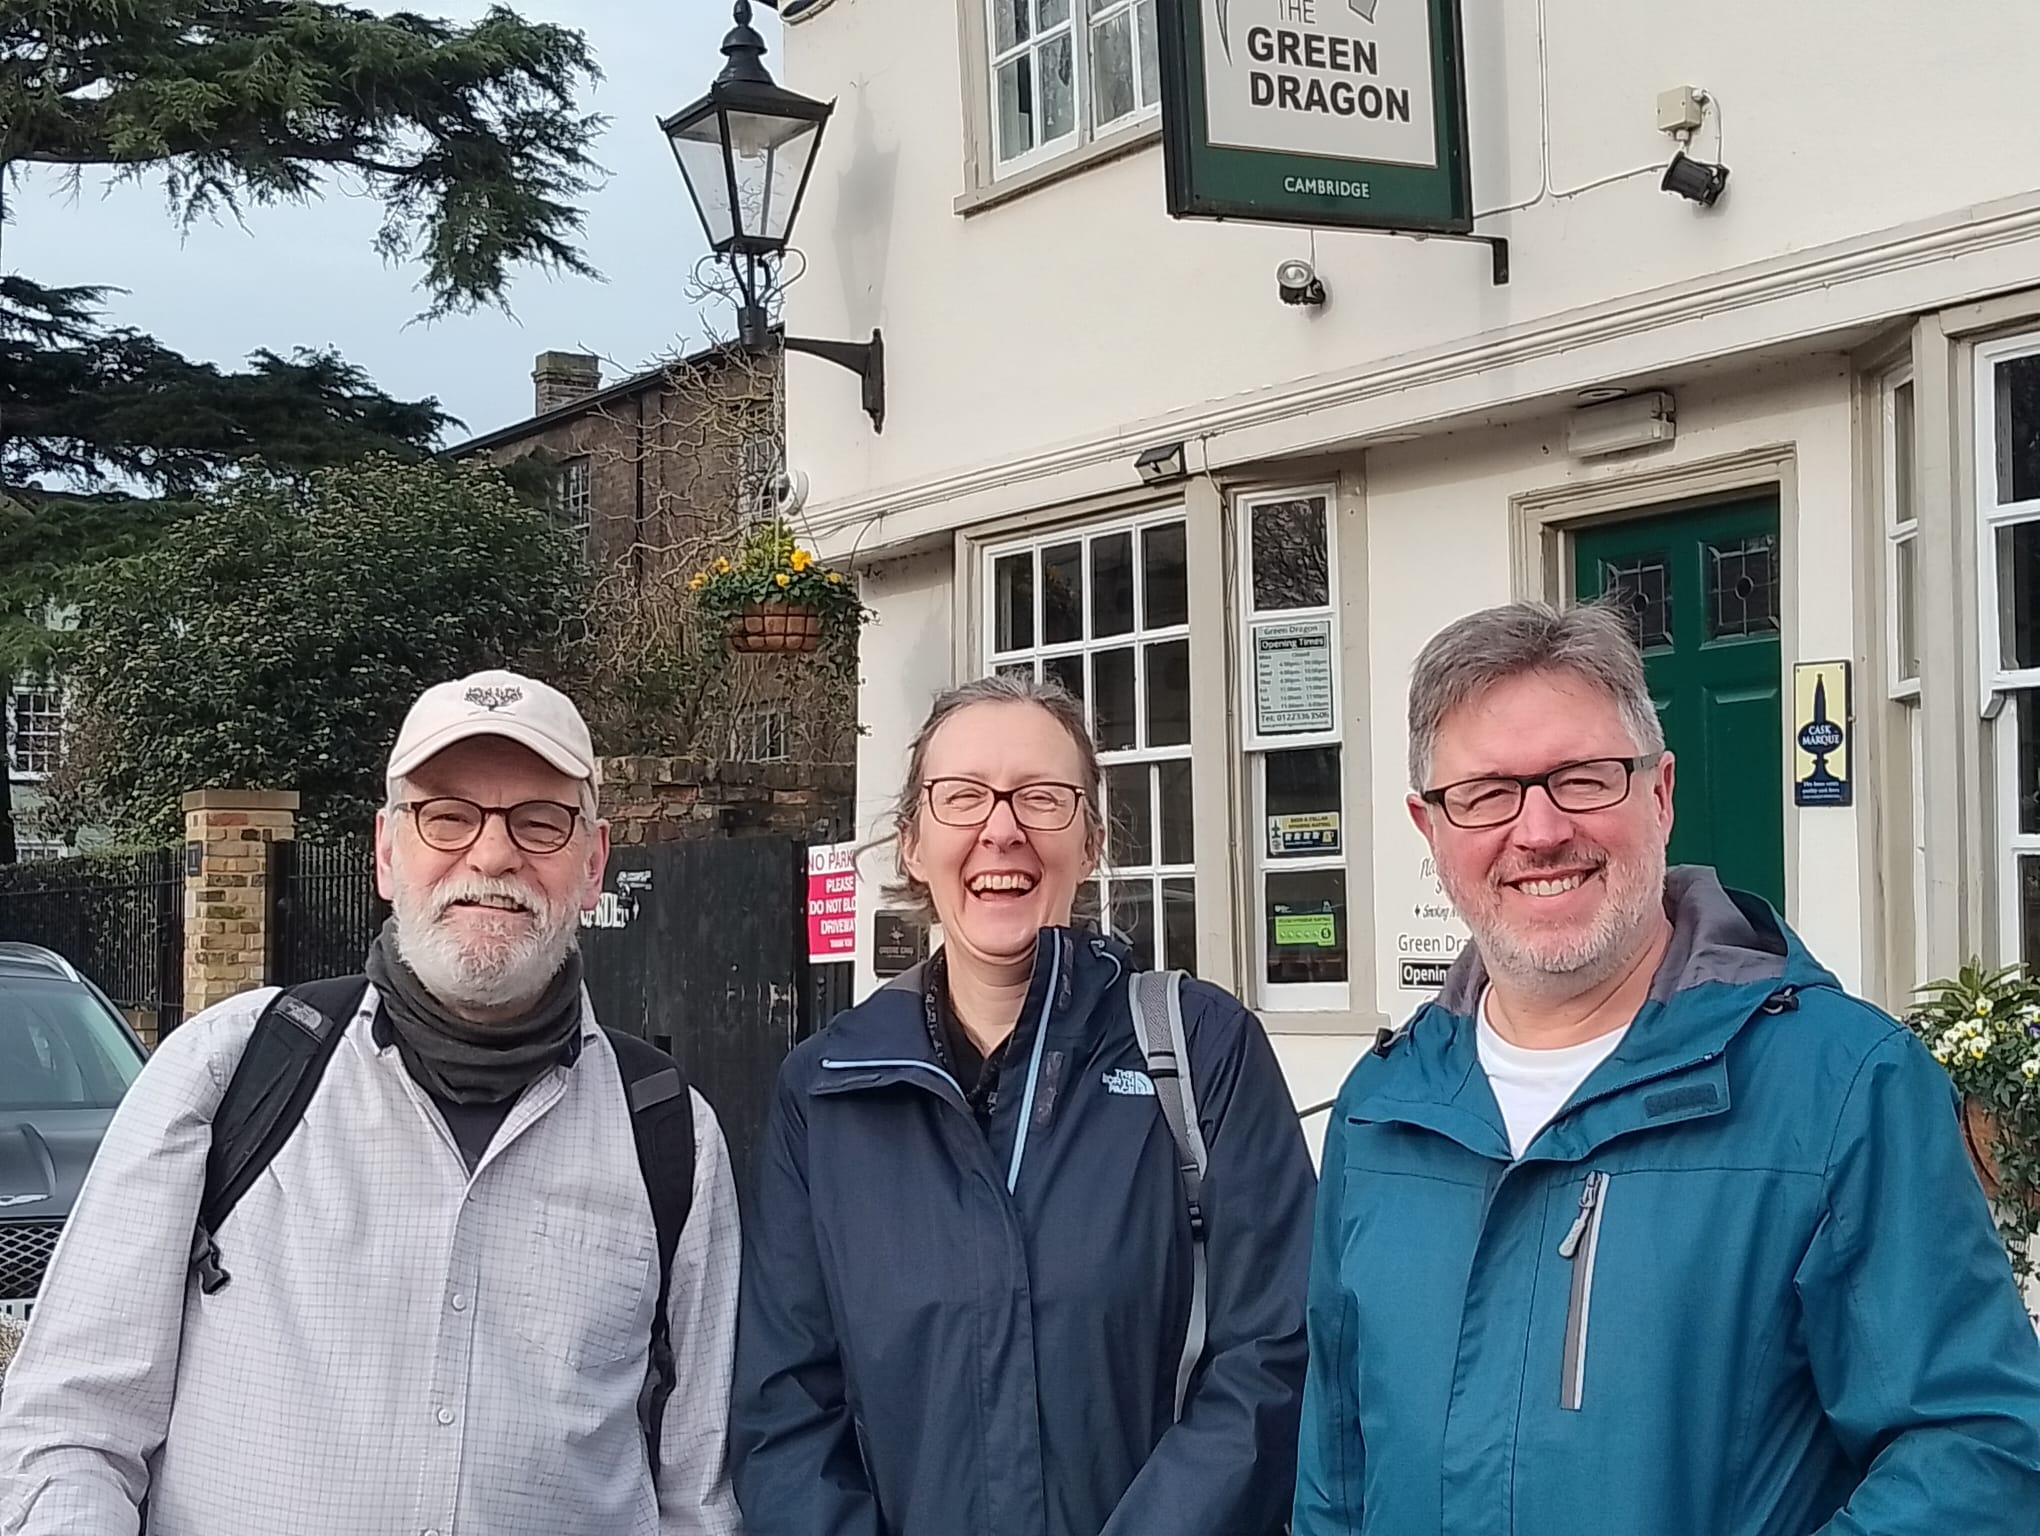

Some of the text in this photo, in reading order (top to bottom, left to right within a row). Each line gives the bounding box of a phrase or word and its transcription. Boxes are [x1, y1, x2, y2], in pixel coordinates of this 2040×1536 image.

[1280, 0, 1316, 24] THE
[1247, 27, 1378, 75] GREEN
[1250, 71, 1410, 123] DRAGON
[1284, 177, 1370, 198] CAMBRIDGE
[1262, 637, 1324, 650] Opening Times
[1808, 725, 1832, 735] CASK
[1802, 735, 1840, 746] MARQUE
[826, 876, 854, 894] PLEASE
[809, 900, 825, 915] DO
[825, 899, 842, 914] NOT
[820, 918, 856, 935] DRIVEWA
[1398, 934, 1441, 952] Green
[1403, 965, 1447, 985] Openin
